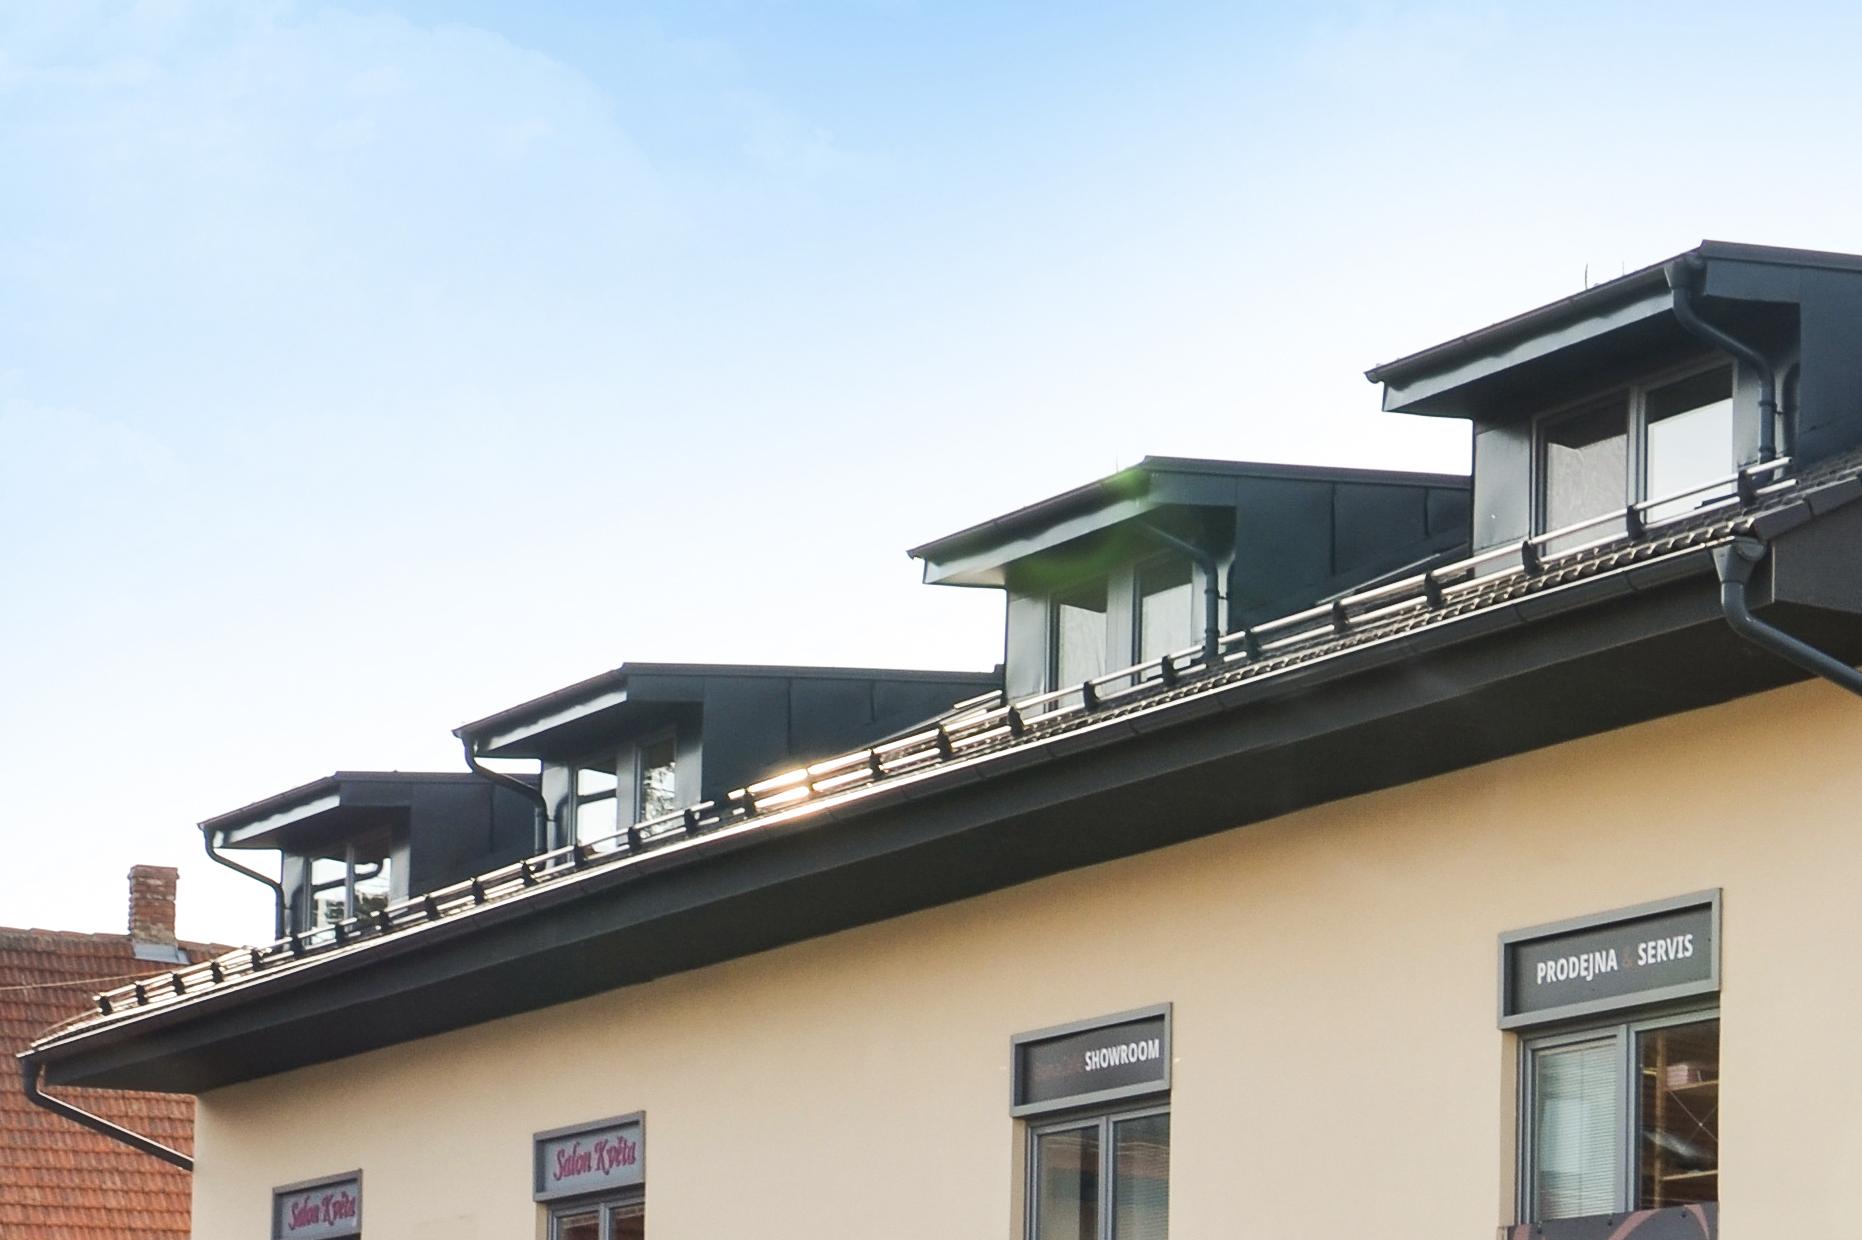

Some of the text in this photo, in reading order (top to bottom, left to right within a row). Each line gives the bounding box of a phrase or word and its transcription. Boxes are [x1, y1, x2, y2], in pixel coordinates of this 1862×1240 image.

[1536, 947, 1618, 984] PRODEJNA
[1638, 933, 1694, 966] SERVIS
[1085, 1038, 1160, 1071] SHOWROOM
[553, 1141, 591, 1180] Salon
